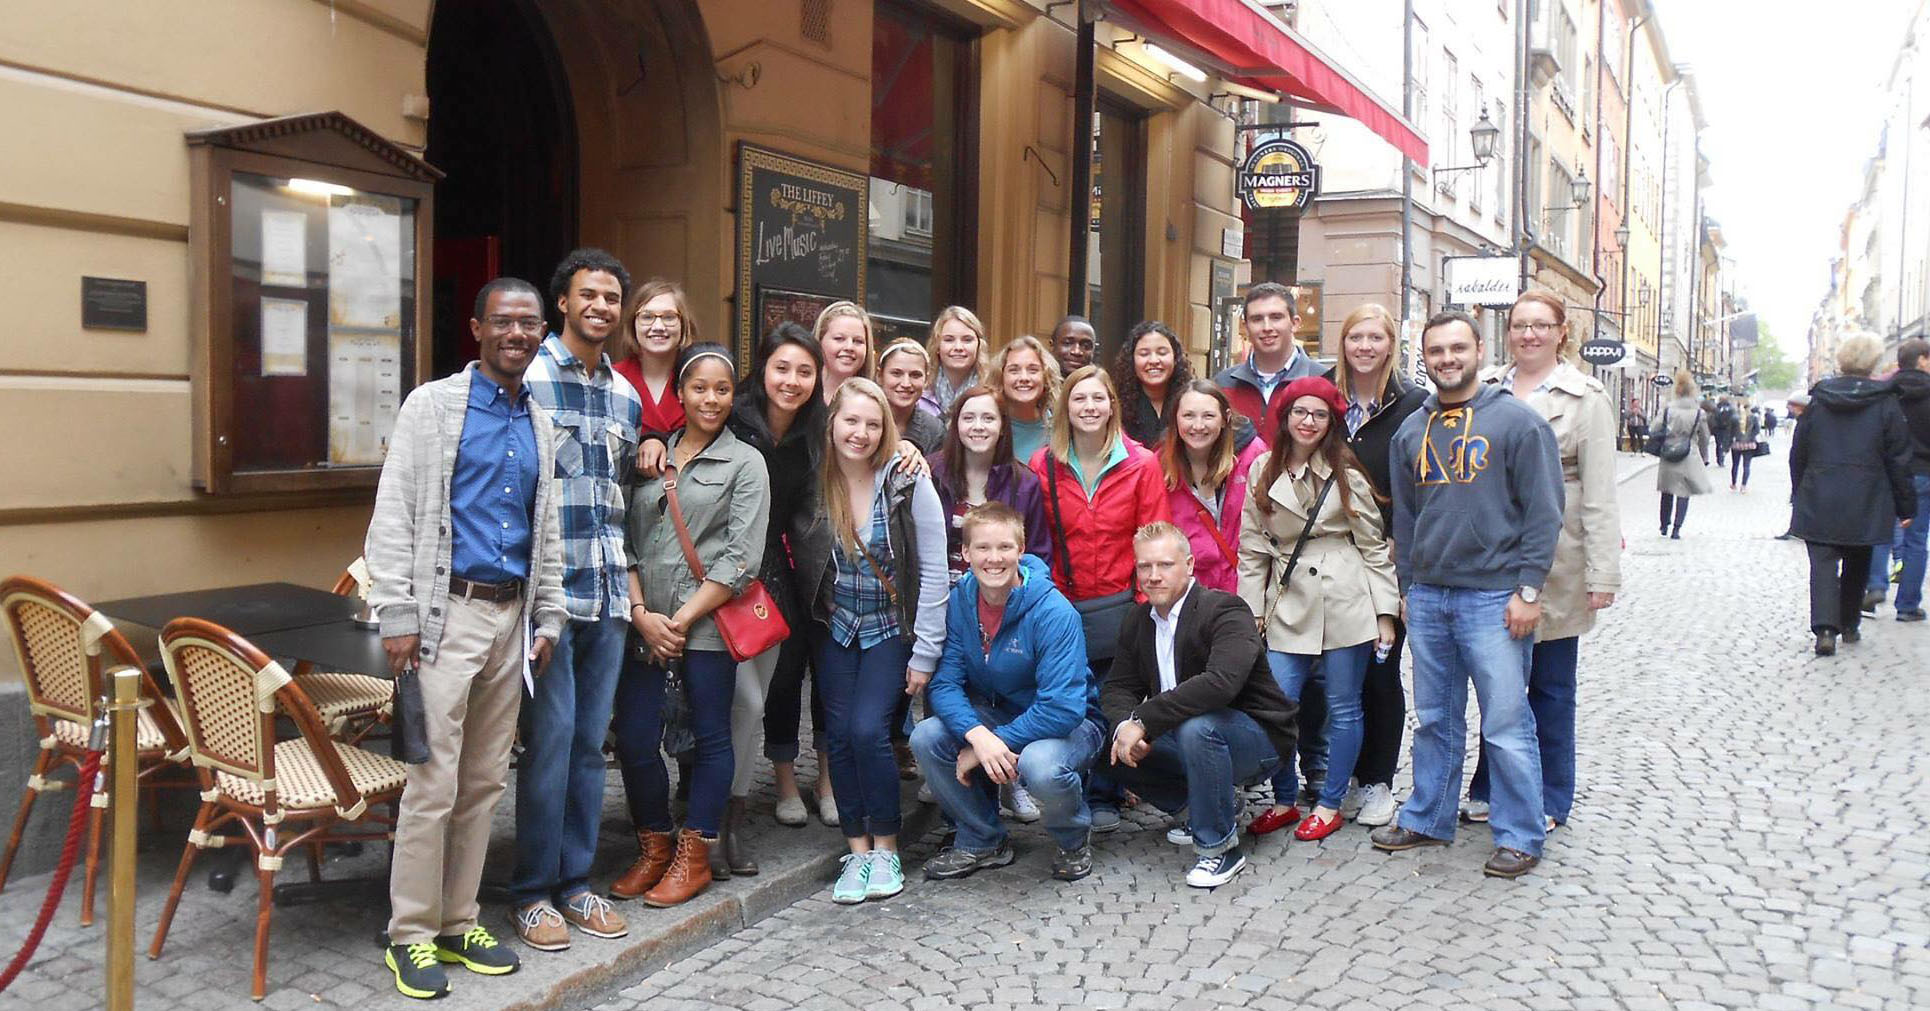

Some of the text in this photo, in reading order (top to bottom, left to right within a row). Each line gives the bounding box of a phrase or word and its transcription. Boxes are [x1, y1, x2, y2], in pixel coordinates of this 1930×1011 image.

[1244, 174, 1310, 188] MAGNERS
[781, 183, 834, 208] THE LIFFEY
